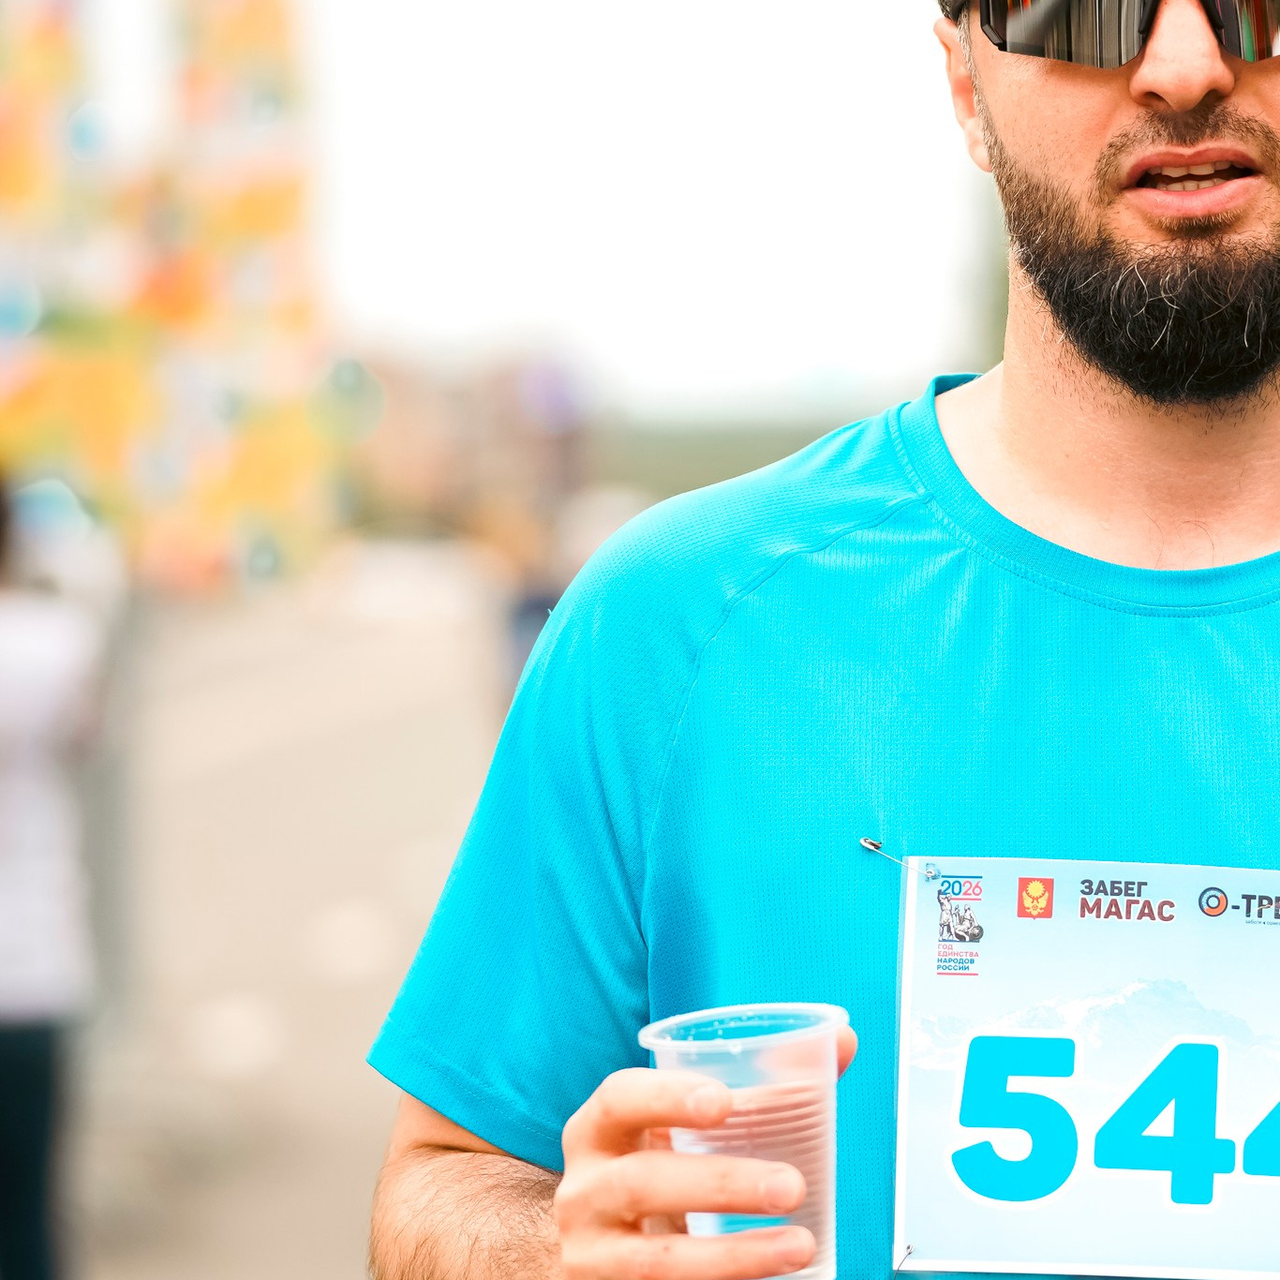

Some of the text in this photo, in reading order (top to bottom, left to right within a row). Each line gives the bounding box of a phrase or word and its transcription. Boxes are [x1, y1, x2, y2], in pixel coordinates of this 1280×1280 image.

[941, 879, 983, 896] 2026
[1080, 879, 1148, 897] ЗАБЕГ
[1080, 897, 1176, 922] МАГАС
[937, 943, 954, 951] ГОД
[937, 950, 980, 958] ЕДИНСТВА
[937, 957, 975, 965] НАРОДОВ
